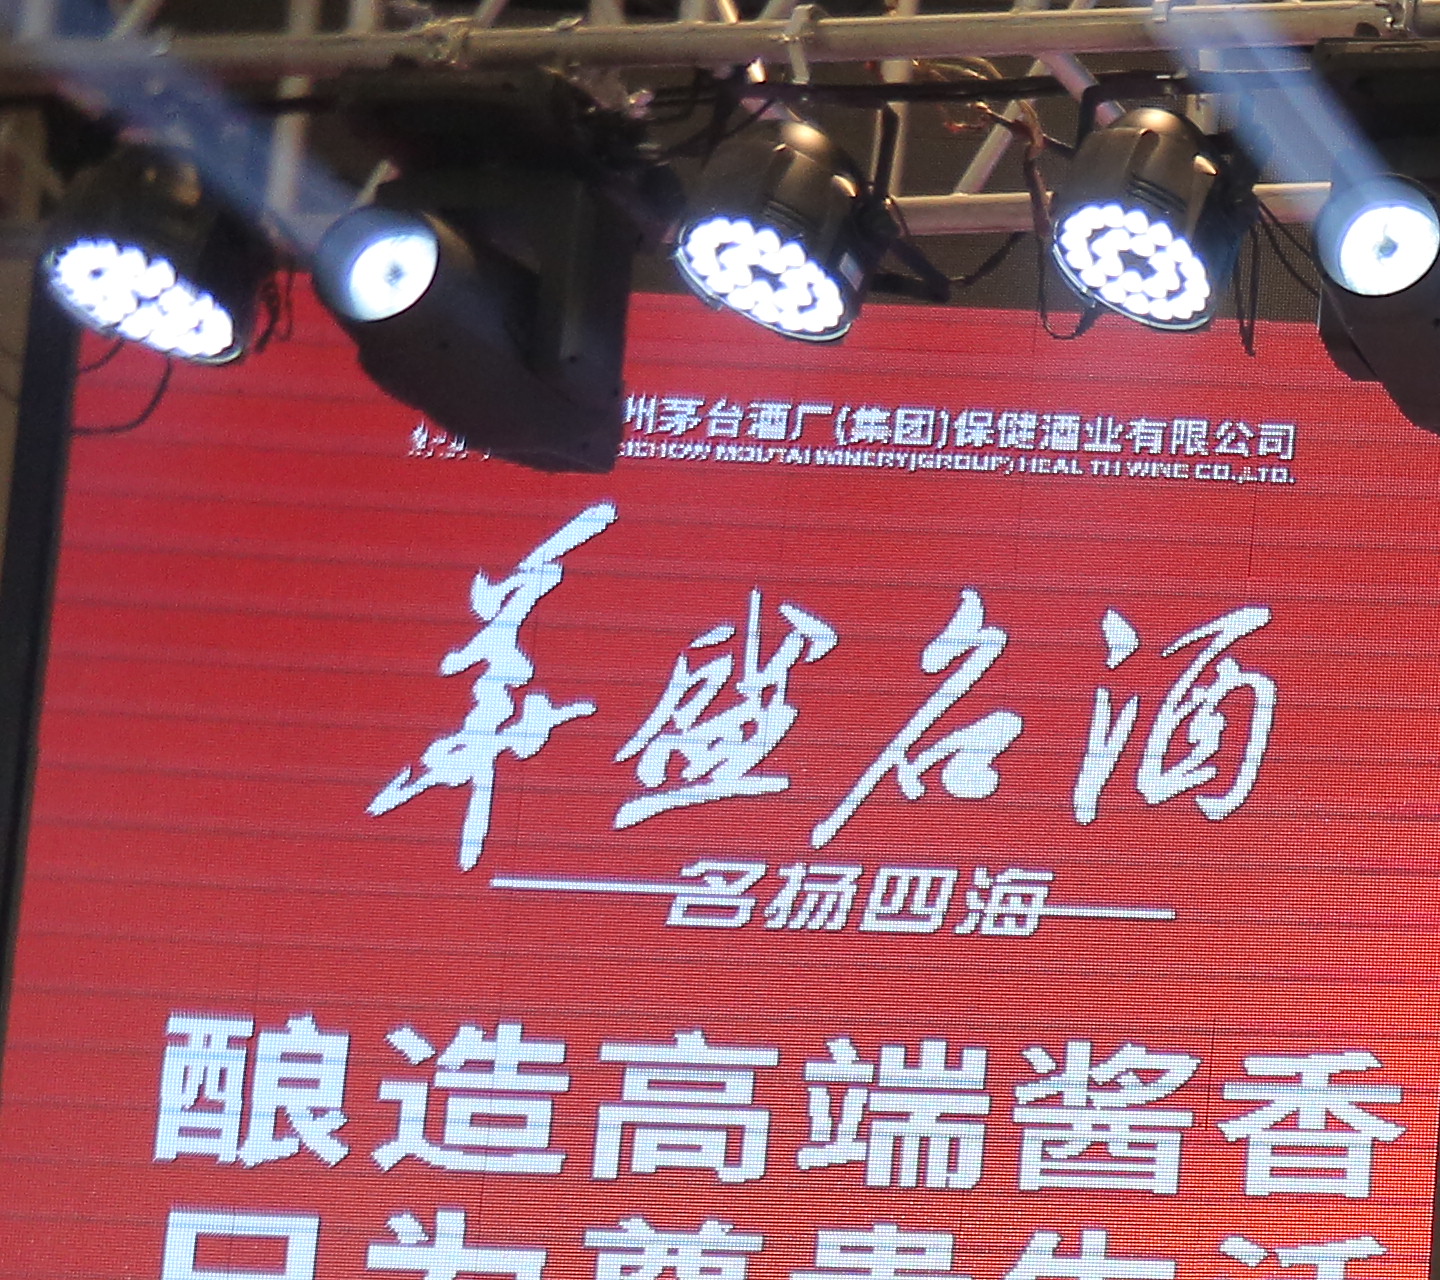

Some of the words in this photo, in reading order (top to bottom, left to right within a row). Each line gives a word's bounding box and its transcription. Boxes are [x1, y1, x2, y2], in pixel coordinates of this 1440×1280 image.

[622, 392, 1297, 461] 州茅台酒厂(集团)保健酒业有限公司
[715, 443, 810, 466] MOUTAI
[665, 857, 1056, 937] 名扬四海
[152, 1010, 1405, 1199] 酿造高端酱香
